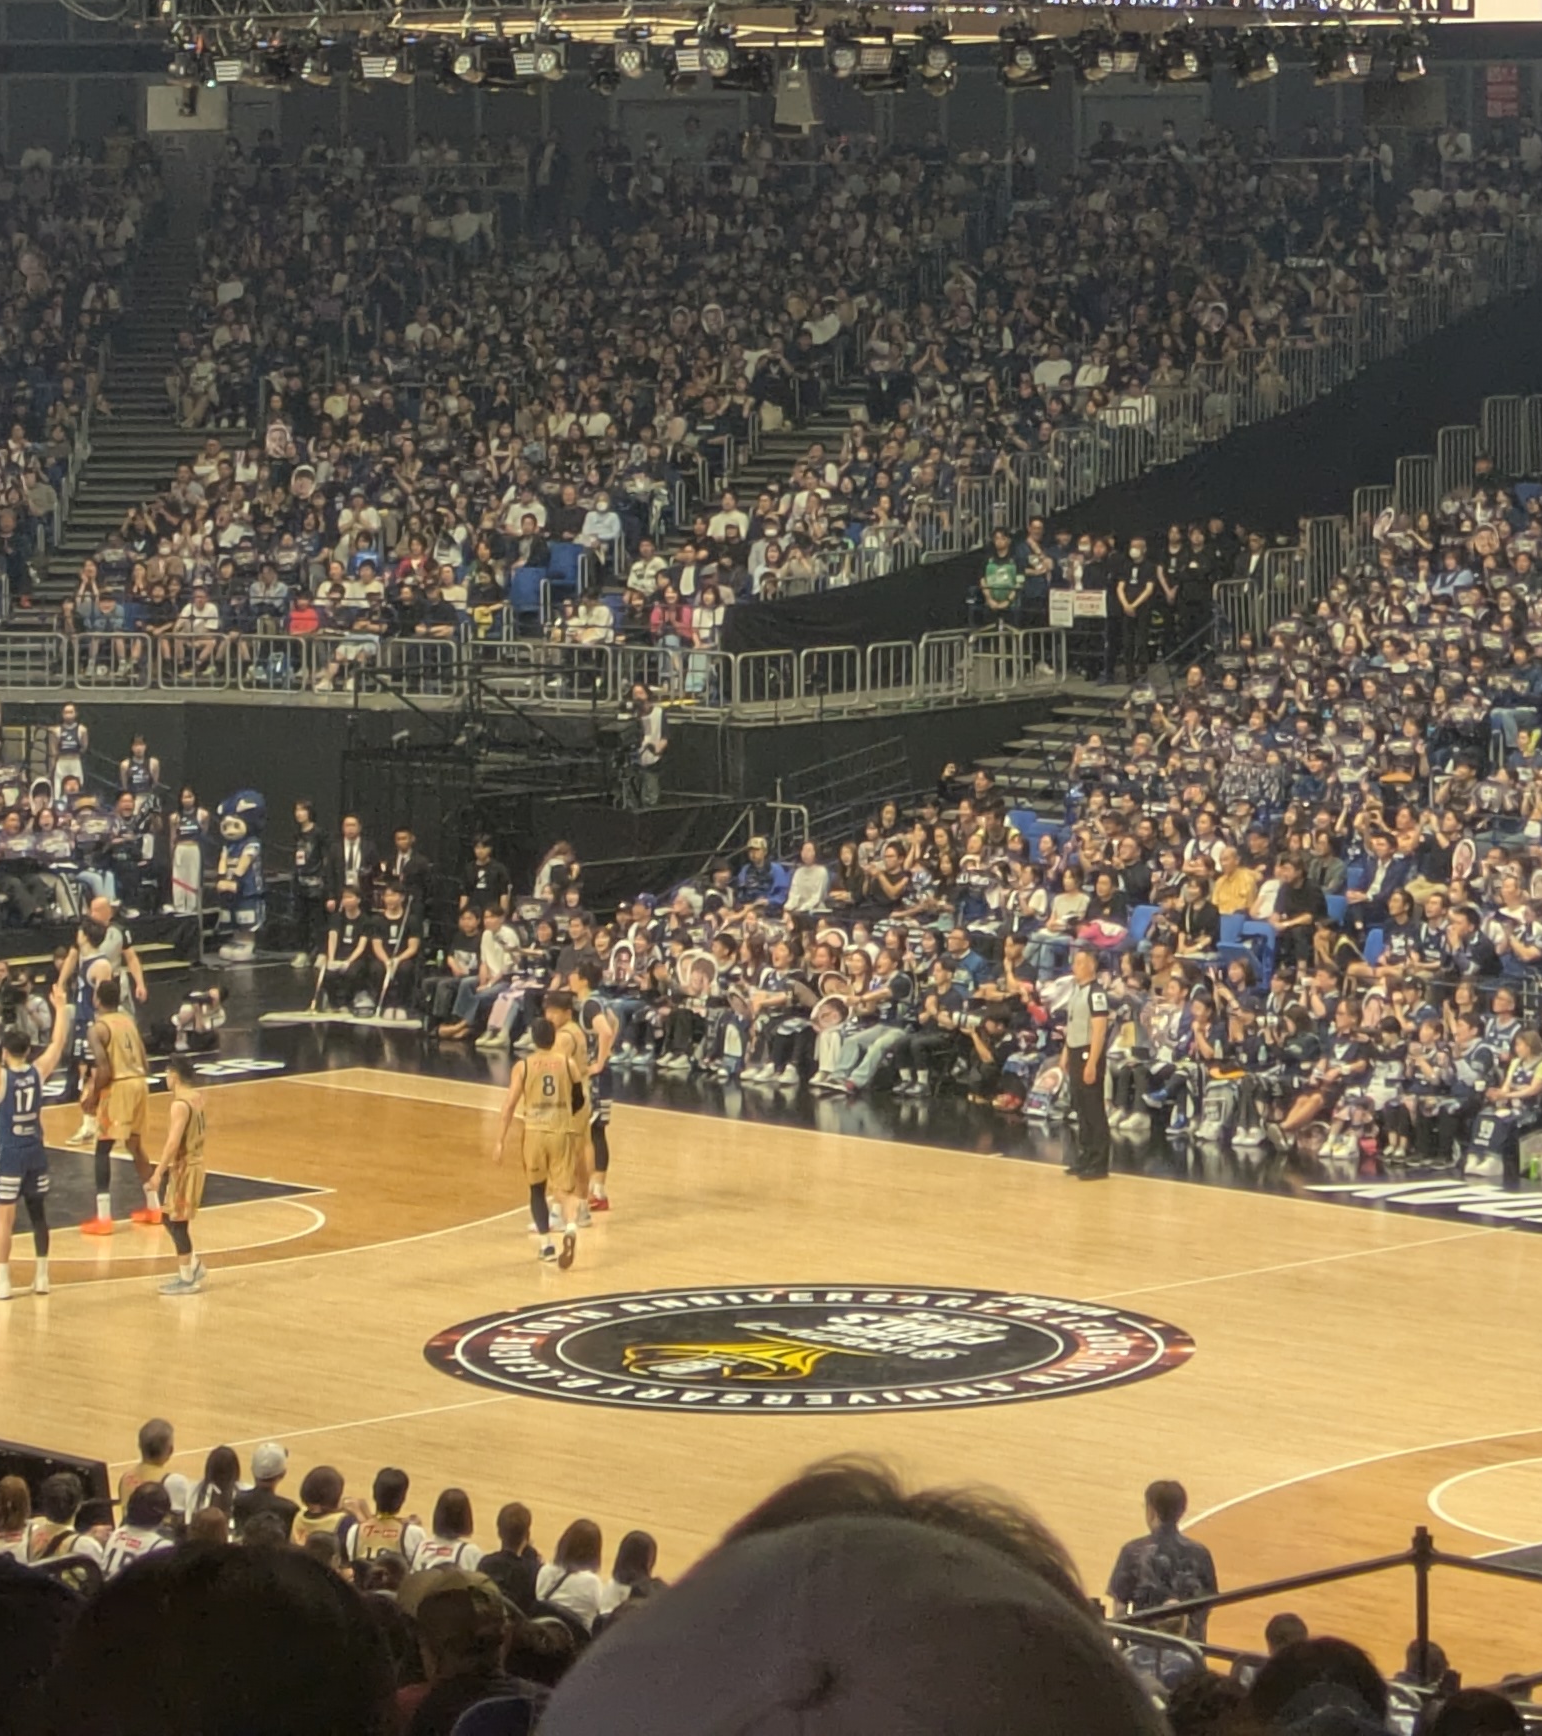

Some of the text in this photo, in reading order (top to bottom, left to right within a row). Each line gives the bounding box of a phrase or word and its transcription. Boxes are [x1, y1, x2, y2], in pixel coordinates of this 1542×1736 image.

[542, 1074, 556, 1097] 8
[15, 1087, 35, 1113] 17
[619, 1291, 1008, 1314] ANNIVERSARY
[597, 1381, 1015, 1406] ANNIVERSARY
